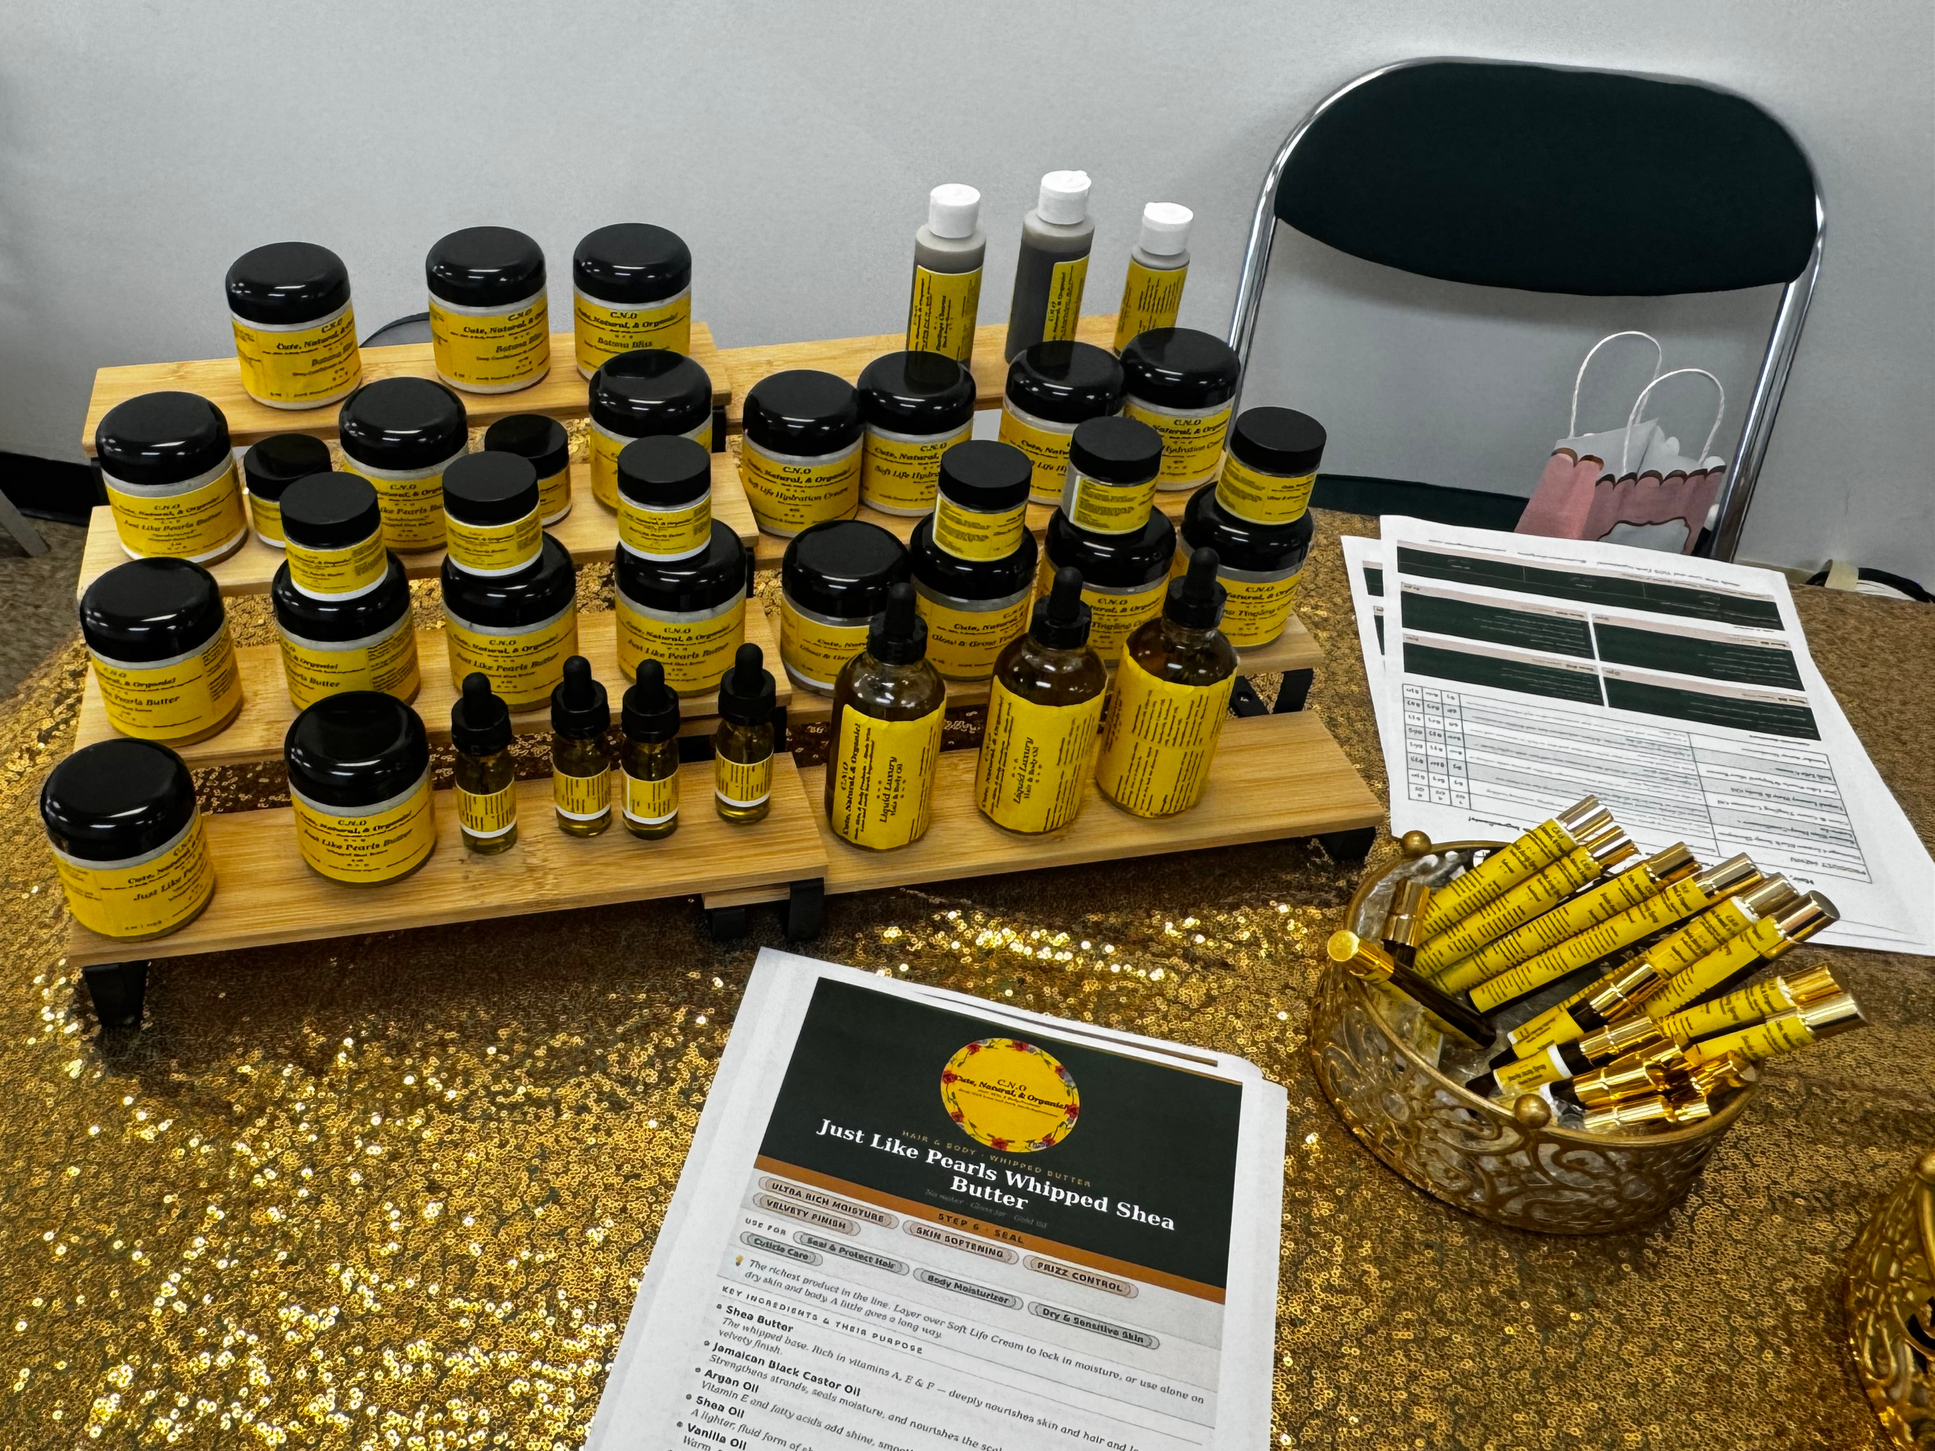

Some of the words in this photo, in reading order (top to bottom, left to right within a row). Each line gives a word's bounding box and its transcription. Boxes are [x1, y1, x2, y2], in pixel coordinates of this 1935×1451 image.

[310, 677, 340, 688] Butter
[146, 696, 180, 706] Butter
[884, 757, 897, 791] Luxury
[1013, 773, 1025, 804] Liquid
[1019, 737, 1033, 772] Luxury
[880, 794, 890, 823] Liquid
[997, 1079, 1027, 1092] C.N.O
[816, 1118, 866, 1144] Just
[869, 1133, 919, 1160] Like
[927, 1148, 997, 1182] Pearls
[1005, 1169, 1108, 1213] Whipped
[1116, 1201, 1176, 1231] Shea
[902, 1130, 929, 1143] HAIR
[946, 1142, 977, 1155] BODY
[989, 1155, 1043, 1174] WHIPPED
[1047, 1170, 1091, 1187] BUTTER
[772, 1181, 802, 1198] ULTRA
[805, 1192, 830, 1206] RICH
[832, 1200, 885, 1224] MOISTURE
[950, 1175, 1029, 1211] Butter
[745, 1217, 764, 1228] USE
[767, 1224, 787, 1236] FOR
[766, 1199, 809, 1218] VELVETY
[811, 1212, 847, 1230] FINISH
[938, 1212, 968, 1227] STEP
[993, 1228, 1025, 1245] SEAL
[754, 1237, 786, 1254] Cuticle
[787, 1246, 809, 1260] Care
[838, 1246, 873, 1264] Protect
[916, 1226, 942, 1241] SKIN
[944, 1234, 1005, 1259] SOFTENING
[927, 1274, 952, 1290] Body
[953, 1280, 1012, 1305] Moisturizer
[1037, 1260, 1069, 1277] FRIZZ
[1072, 1269, 1124, 1293] CONTROL
[722, 1286, 742, 1297] KEY
[746, 1293, 818, 1321] INGREDIENTS
[835, 1321, 867, 1336] THEIR
[872, 1332, 923, 1355] PURPOSE
[726, 1305, 754, 1321] Shea
[757, 1315, 794, 1333] Butter
[745, 1271, 761, 1282] dry
[763, 1277, 782, 1288] skin
[784, 1282, 802, 1294] and
[830, 1297, 838, 1305] A
[840, 1300, 863, 1312] little
[864, 1307, 887, 1321] goes
[897, 1317, 919, 1332] long
[922, 1325, 943, 1339] way.
[718, 1329, 752, 1346] velvety
[749, 1259, 767, 1271] The
[769, 1266, 801, 1282] richest
[803, 1277, 839, 1295] product
[841, 1288, 850, 1297] in
[853, 1291, 868, 1302] the
[893, 1304, 922, 1319] Layer
[923, 1315, 945, 1326] over
[946, 1321, 967, 1334] Soft
[970, 1327, 988, 1340] Life
[990, 1334, 1023, 1351] Cream
[1026, 1344, 1036, 1355] to
[1039, 1349, 1059, 1362] lock
[1062, 1356, 1072, 1365] in
[1075, 1360, 1122, 1381] moisture,
[1126, 1374, 1137, 1384] or
[1140, 1379, 1158, 1390] use
[1160, 1384, 1189, 1399] alone
[1191, 1395, 1204, 1404] on
[1042, 1307, 1061, 1321] Dry
[1073, 1316, 1121, 1338] Sensitive
[1121, 1331, 1145, 1346] Skin
[704, 1369, 739, 1387] Argan
[743, 1381, 760, 1394] Oil
[712, 1341, 765, 1366] Jamaican
[768, 1359, 799, 1377] Black
[803, 1371, 841, 1390] Castor
[844, 1384, 861, 1397] Oil
[722, 1317, 740, 1329] The
[742, 1323, 783, 1342] whipped
[786, 1336, 809, 1350] base.
[812, 1344, 834, 1359] Rich
[836, 1353, 846, 1363] in
[849, 1357, 889, 1376] vitamins
[905, 1375, 913, 1384] E
[915, 1379, 924, 1388] &
[948, 1389, 983, 1408] deeply
[985, 1401, 1034, 1423] nourishes
[1036, 1416, 1059, 1430] skin
[1060, 1426, 1080, 1438] and
[1083, 1430, 1106, 1445] hair
[696, 1395, 725, 1412] Shea
[728, 1406, 745, 1419] Oil
[701, 1380, 738, 1400] Vitamin
[740, 1394, 749, 1403] E
[750, 1398, 769, 1409] and
[770, 1404, 795, 1419] fatty
[796, 1414, 822, 1428] acids
[824, 1423, 844, 1435] add
[846, 1430, 876, 1447] shine,
[709, 1354, 768, 1380] Strengthens
[770, 1375, 809, 1394] strands,
[812, 1389, 837, 1402] seals
[839, 1397, 886, 1419] moisture,
[887, 1413, 908, 1425] and
[909, 1421, 959, 1442] nourishes
[962, 1436, 978, 1448] the
[687, 1422, 726, 1444] Vanilla
[730, 1438, 747, 1451] Oil
[690, 1409, 699, 1417] A
[700, 1410, 736, 1430] lighter,
[737, 1423, 762, 1437] fluid
[762, 1431, 787, 1447] form
